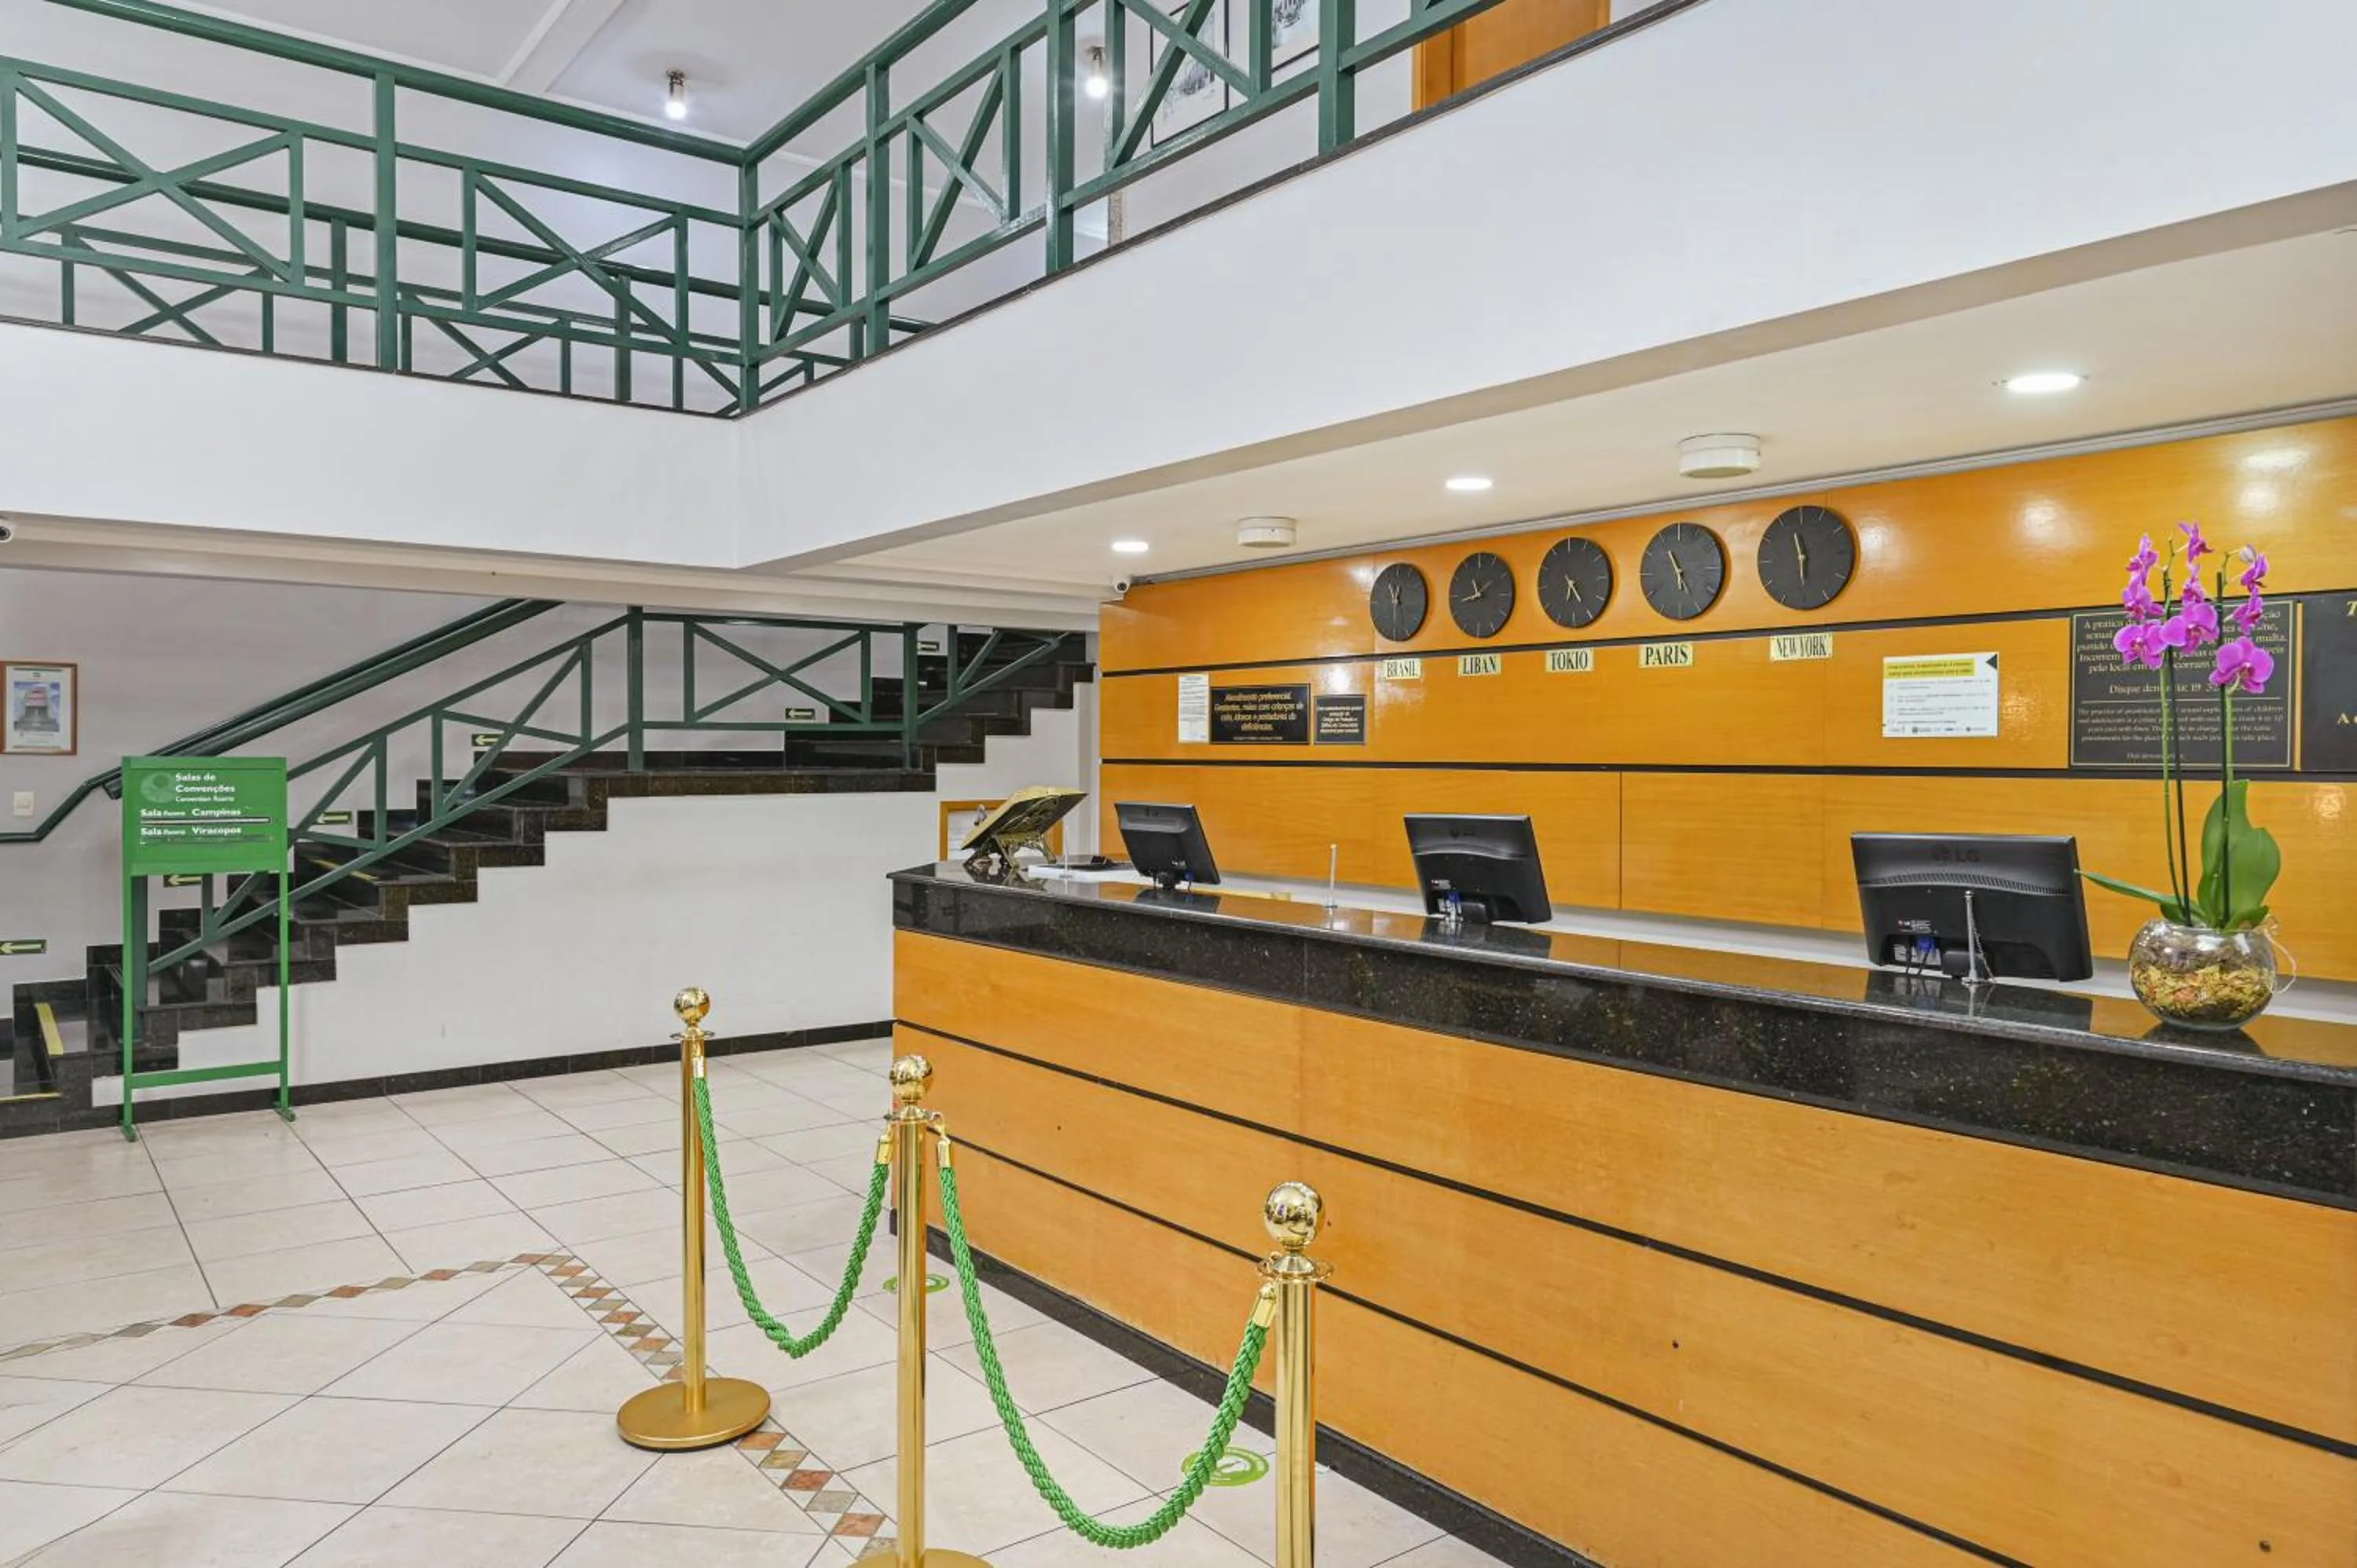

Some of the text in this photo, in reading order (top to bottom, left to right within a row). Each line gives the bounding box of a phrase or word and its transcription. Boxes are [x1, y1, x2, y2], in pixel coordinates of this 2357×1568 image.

[1552, 650, 1589, 671] TOKIO
[1645, 644, 1688, 665] PARIS
[1387, 660, 1417, 677] BRASIL
[175, 771, 217, 782] Salas de
[140, 808, 163, 818] Sala
[191, 808, 242, 818] Campinas
[140, 827, 163, 837] Sala
[191, 826, 242, 837] Viracopos
